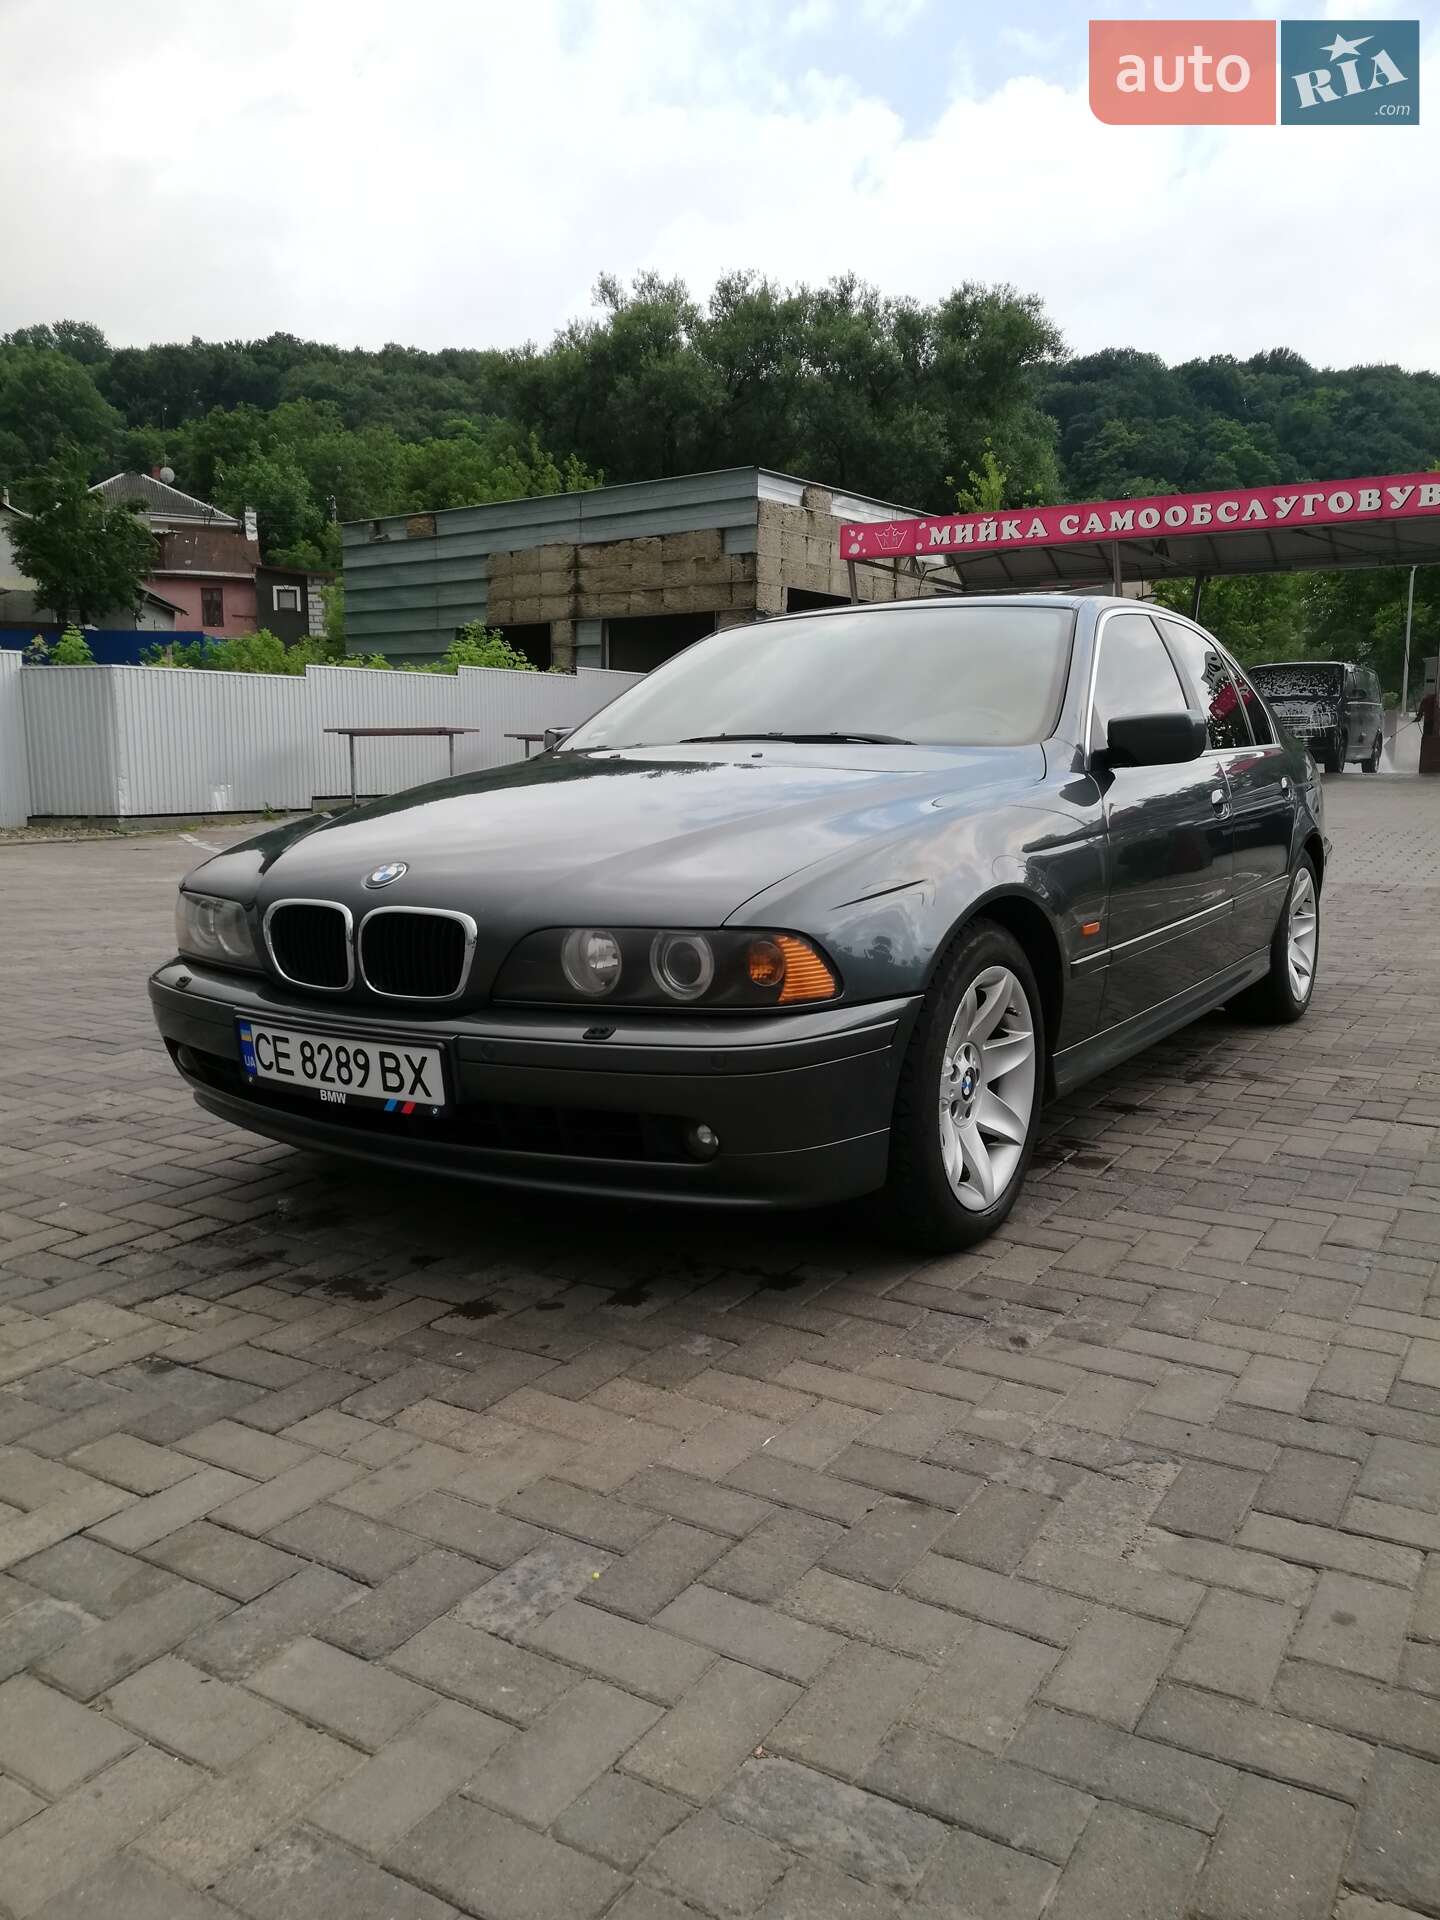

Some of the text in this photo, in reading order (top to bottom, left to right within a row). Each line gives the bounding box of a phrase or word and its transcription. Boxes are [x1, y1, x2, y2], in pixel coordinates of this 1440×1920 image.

[929, 517, 1049, 546] МИЙКА
[244, 1055, 256, 1069] UA
[255, 1033, 432, 1098] CE 8289 BX
[319, 1089, 346, 1105] BMW
